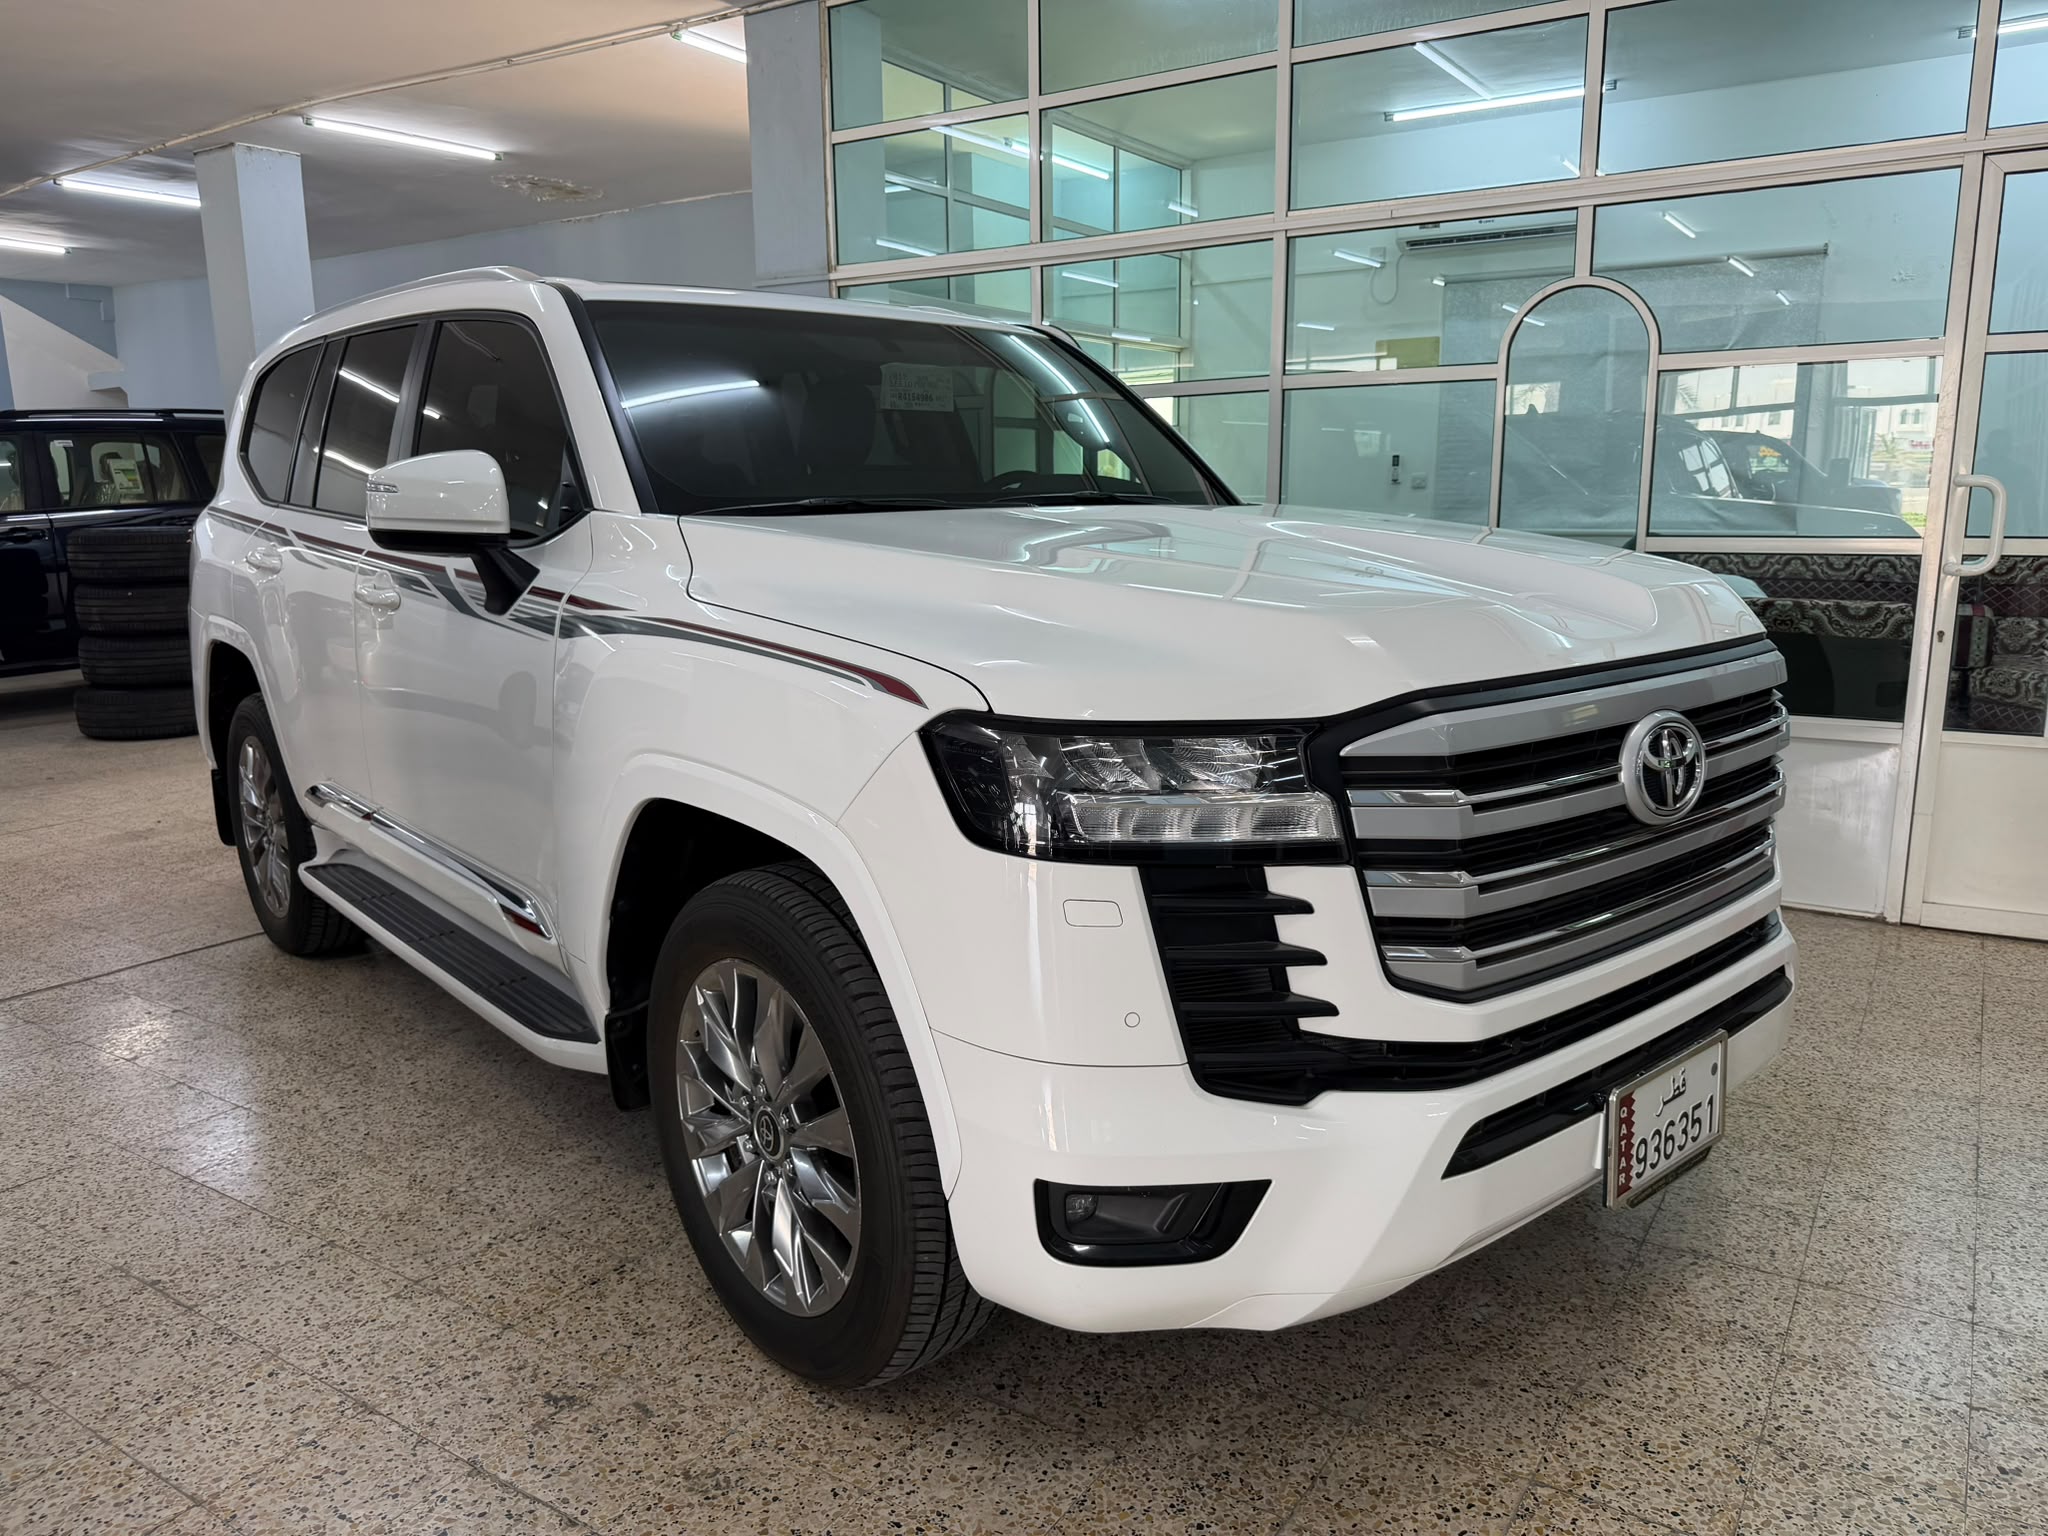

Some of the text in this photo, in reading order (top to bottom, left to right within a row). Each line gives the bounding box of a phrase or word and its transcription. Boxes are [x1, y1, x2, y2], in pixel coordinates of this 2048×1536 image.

[1654, 1067, 1686, 1117] قطر
[1618, 1106, 1628, 1186] QATAR
[1634, 1093, 1714, 1179] 936351
